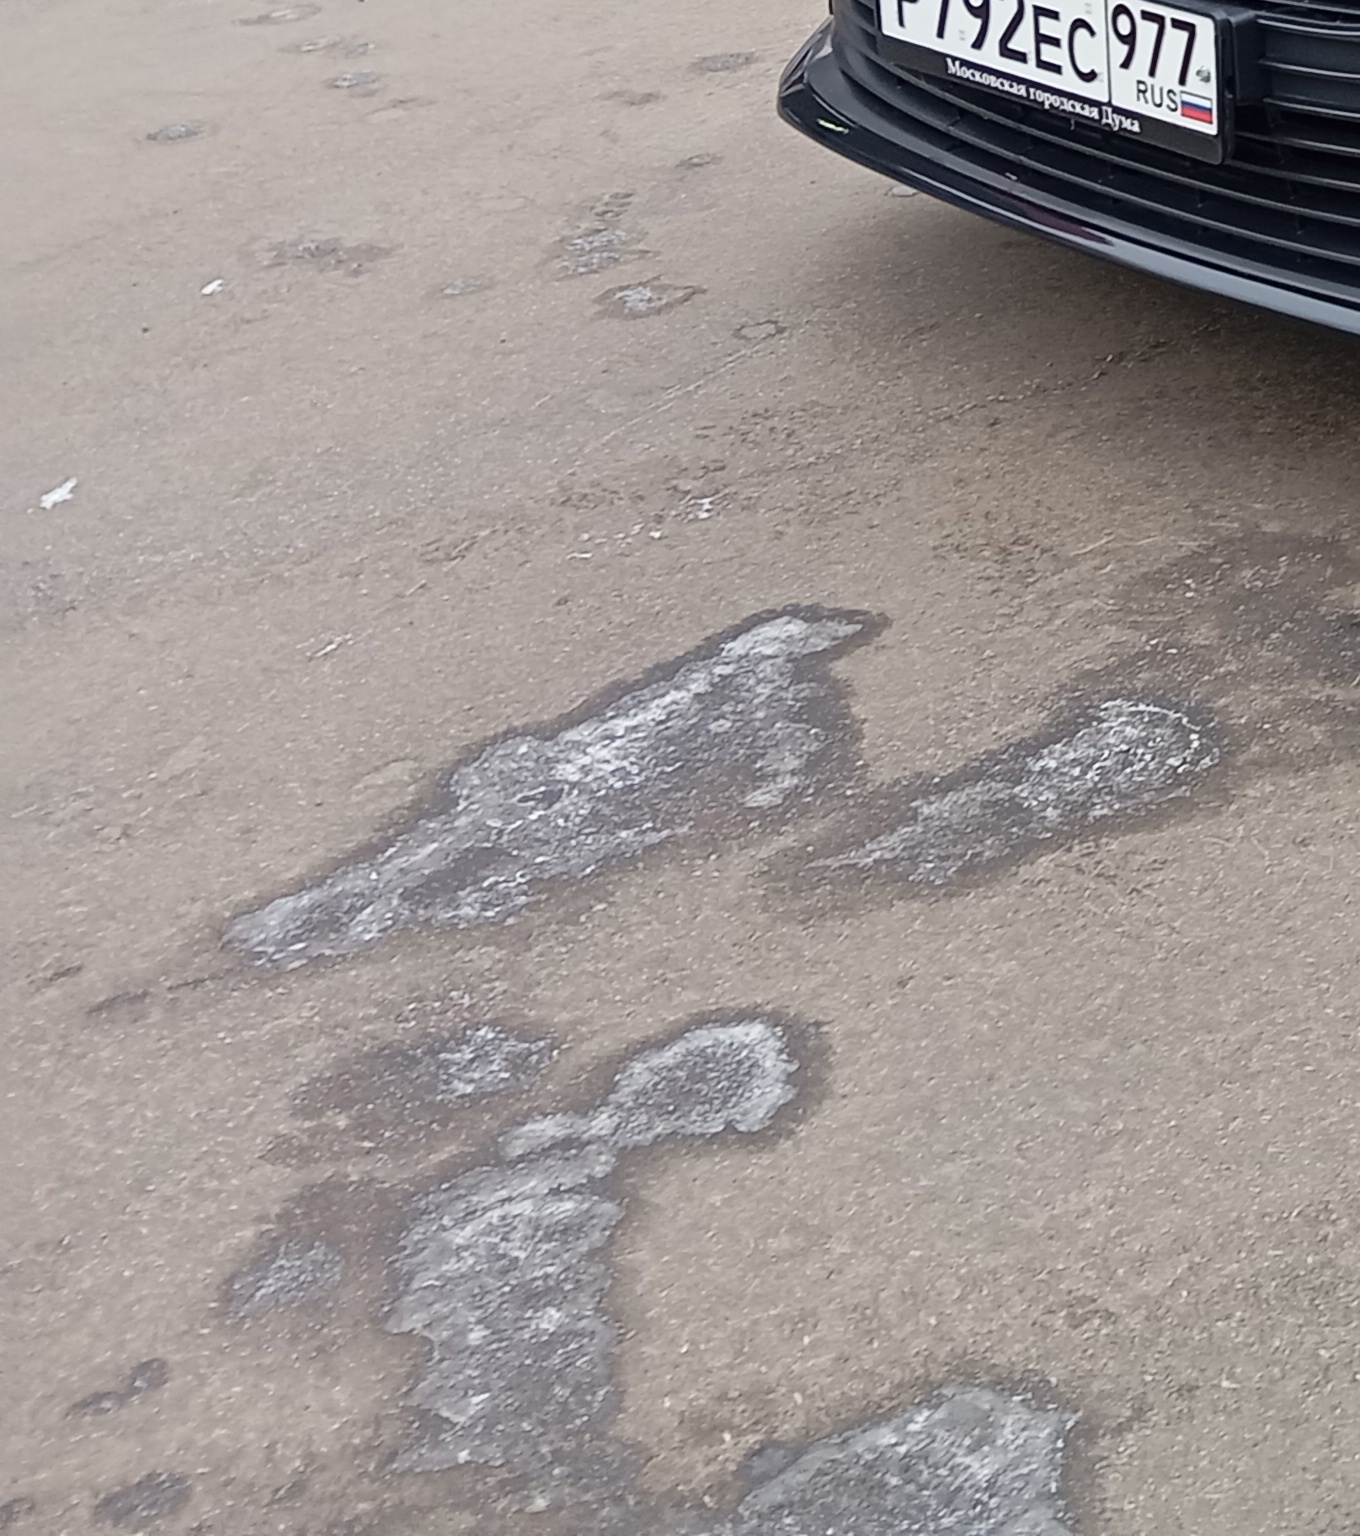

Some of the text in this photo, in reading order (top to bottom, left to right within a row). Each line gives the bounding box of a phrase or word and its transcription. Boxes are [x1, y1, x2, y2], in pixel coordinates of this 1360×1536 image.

[1111, 3, 1197, 86] 977
[945, 57, 1141, 133] Московская городская Дума
[1136, 79, 1179, 113] RUS
